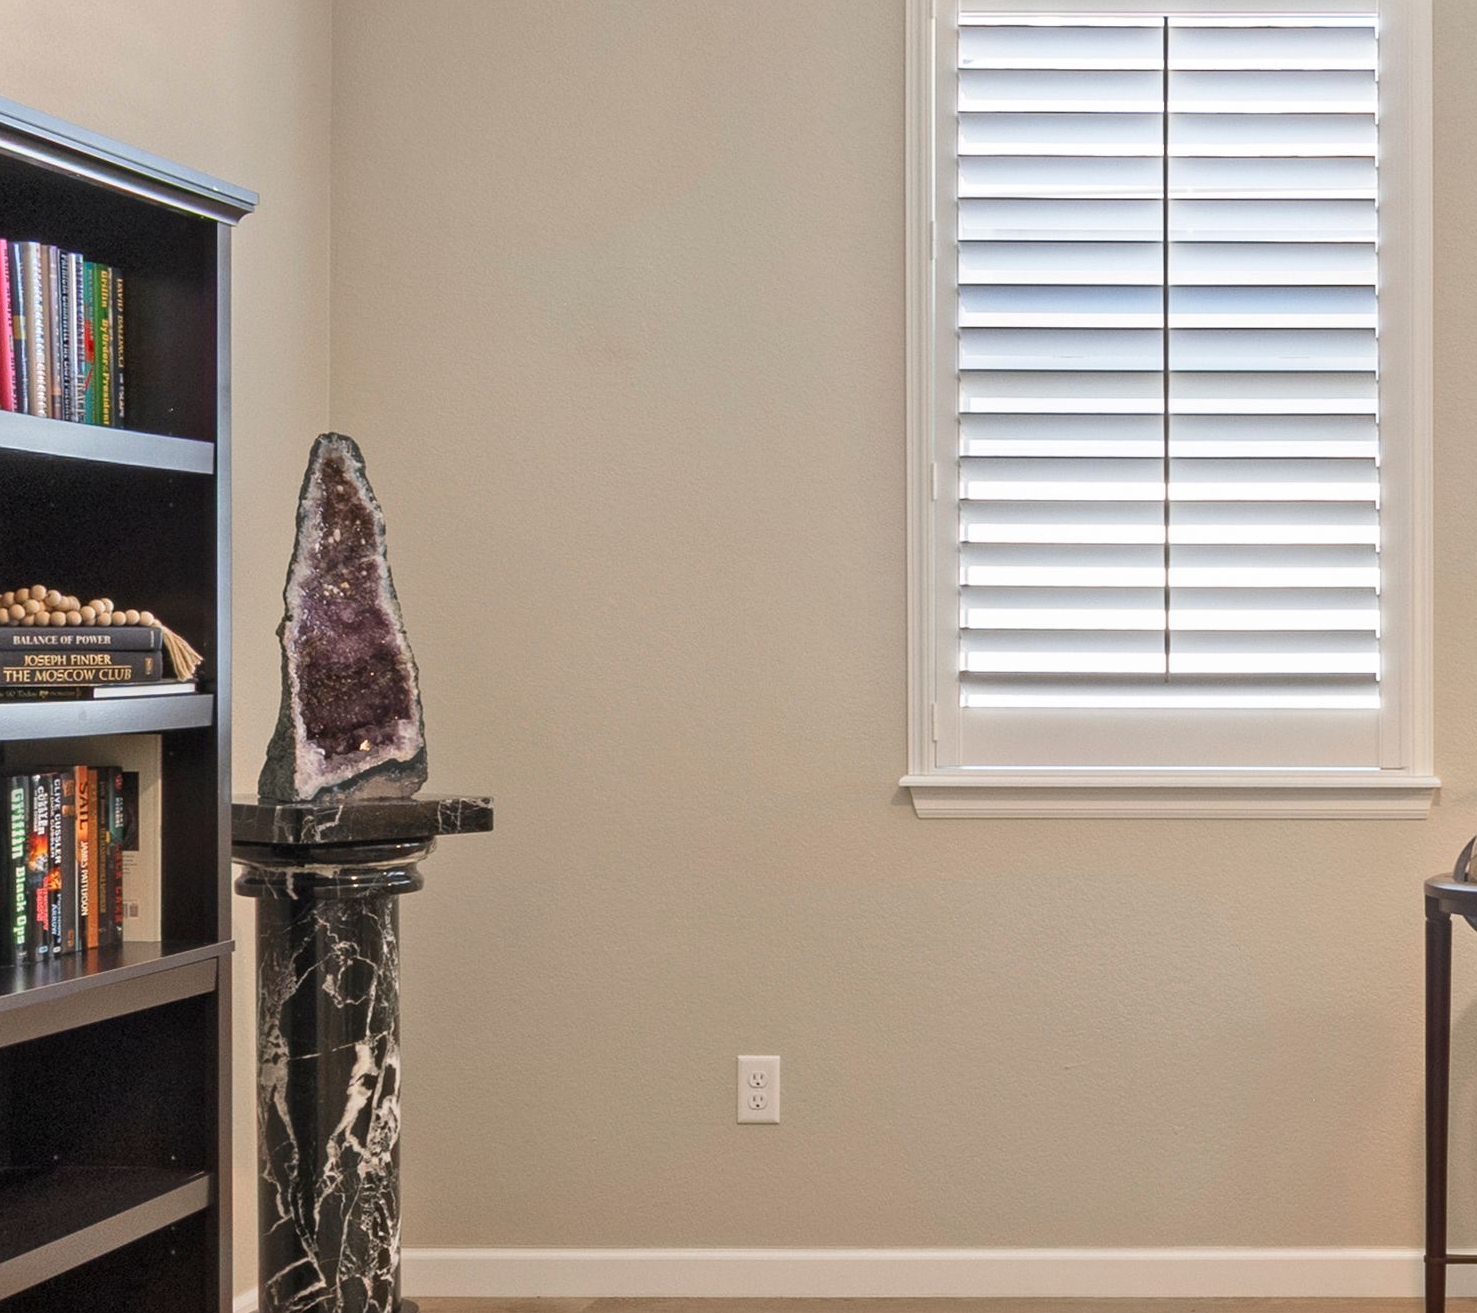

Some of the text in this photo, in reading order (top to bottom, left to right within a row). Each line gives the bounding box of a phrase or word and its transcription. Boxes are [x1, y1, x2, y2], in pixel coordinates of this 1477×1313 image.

[99, 270, 111, 425] Griffin By Order President
[12, 635, 111, 645] BALANCE OF POWER
[23, 654, 112, 666] JOSEPH FINDER
[2, 668, 132, 683] THE MOSCOW CLUB
[53, 778, 62, 864] CLIVE CUSSLER
[79, 781, 90, 831] SAIL
[11, 788, 27, 944] Griffin Black Ops
[80, 840, 90, 916] JAMES PATTERSON
